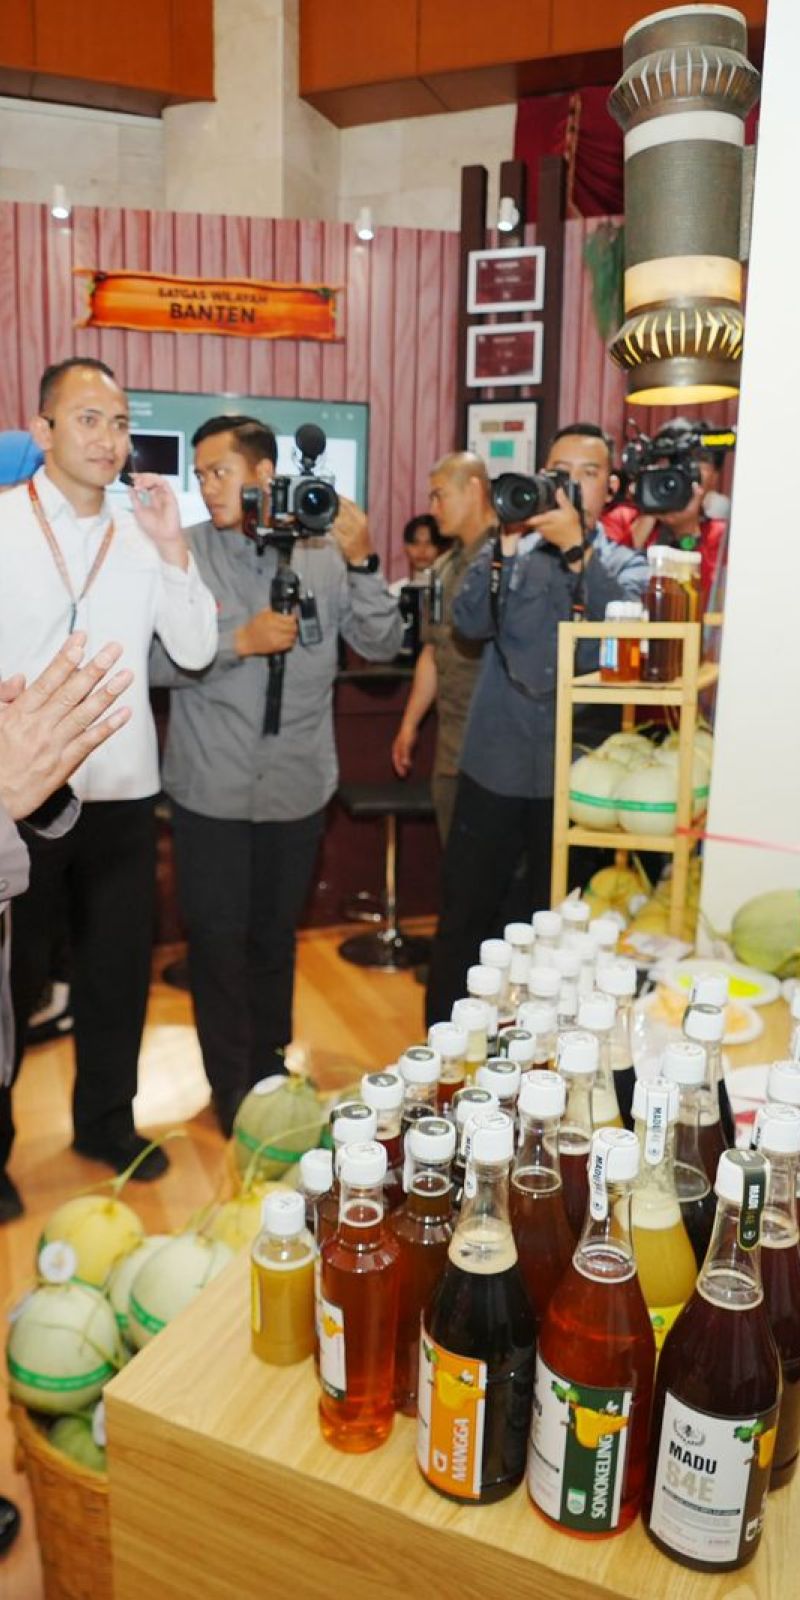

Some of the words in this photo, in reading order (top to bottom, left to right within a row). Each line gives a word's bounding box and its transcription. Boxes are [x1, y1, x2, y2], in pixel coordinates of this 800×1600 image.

[170, 303, 255, 323] BANTEN
[211, 290, 267, 304] WILAYAH
[452, 1418, 469, 1482] MANGGA
[669, 1440, 717, 1474] MADU
[591, 1434, 614, 1520] SONOKELING
[666, 1460, 715, 1502] S4E
